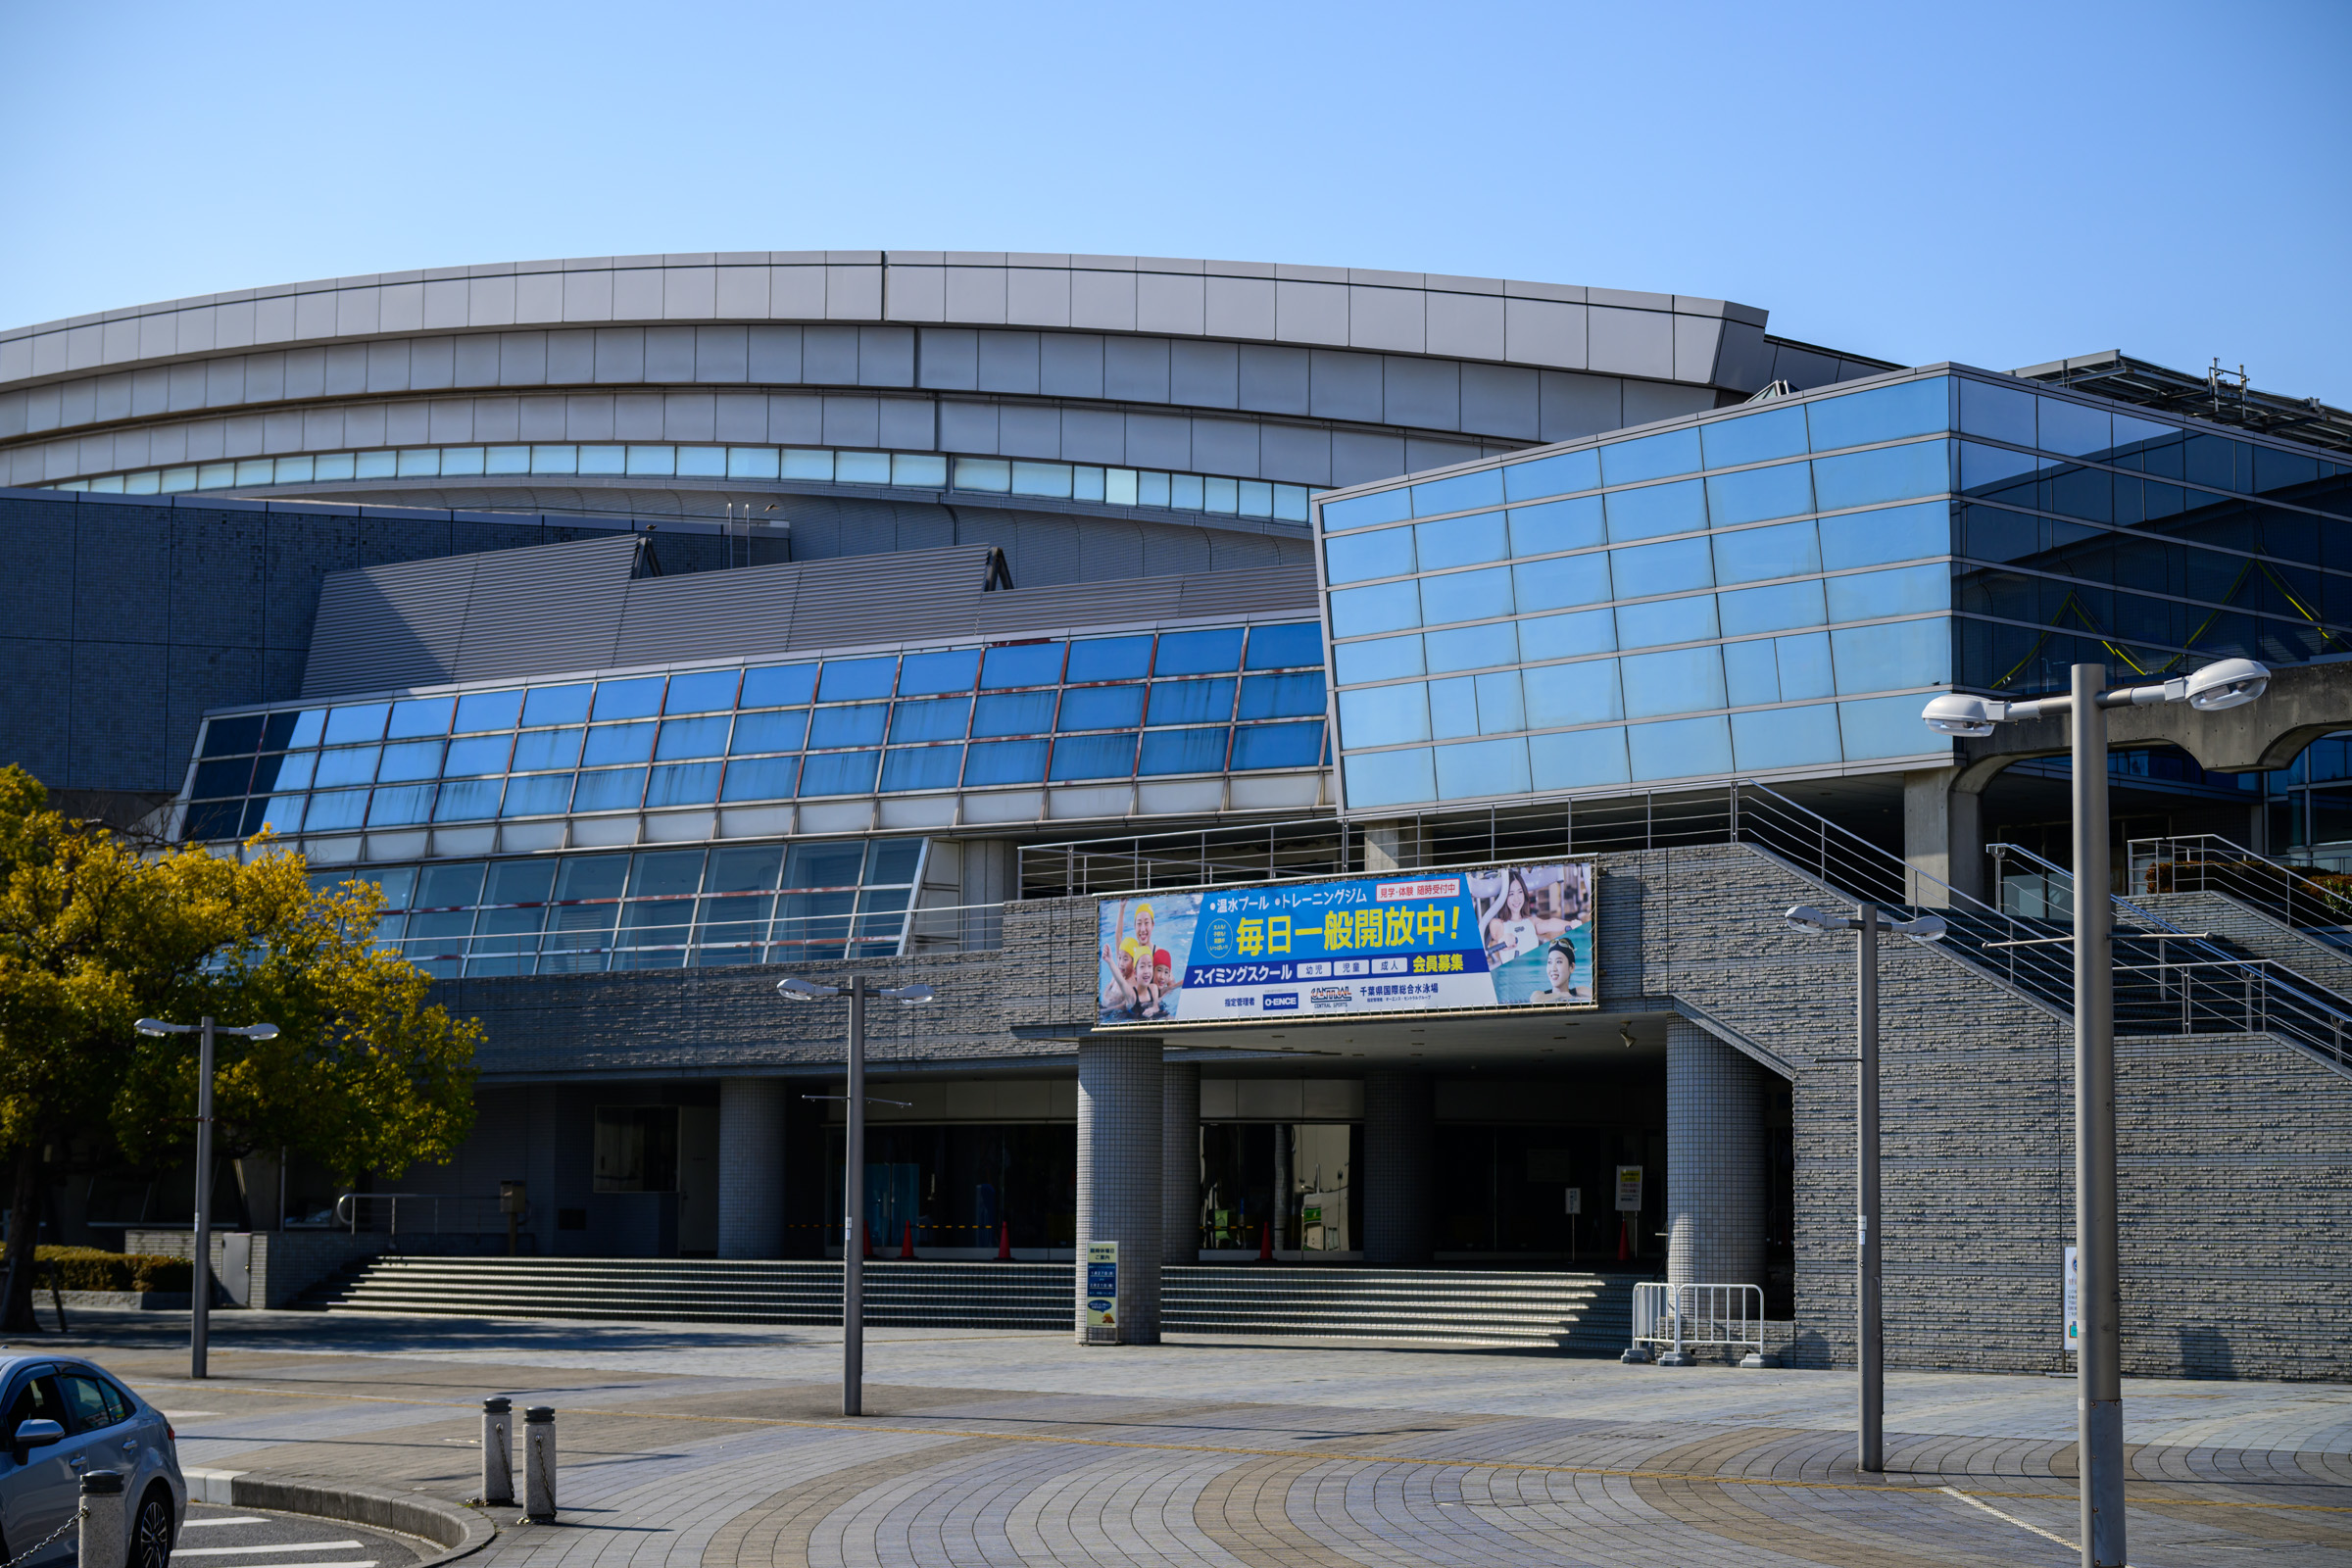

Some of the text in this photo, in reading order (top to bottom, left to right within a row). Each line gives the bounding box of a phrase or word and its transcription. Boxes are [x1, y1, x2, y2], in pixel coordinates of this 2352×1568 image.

[1216, 887, 1367, 913] 温水プール トレーニングジム
[1380, 883, 1455, 899] 見学・体験 随時受付中
[1236, 904, 1460, 956] 毎日一般開放中!
[1194, 954, 1464, 985] スイミングスクール 幼児 児童 成人 会員募集
[1359, 983, 1439, 997] 千葉県国際総合水泳場
